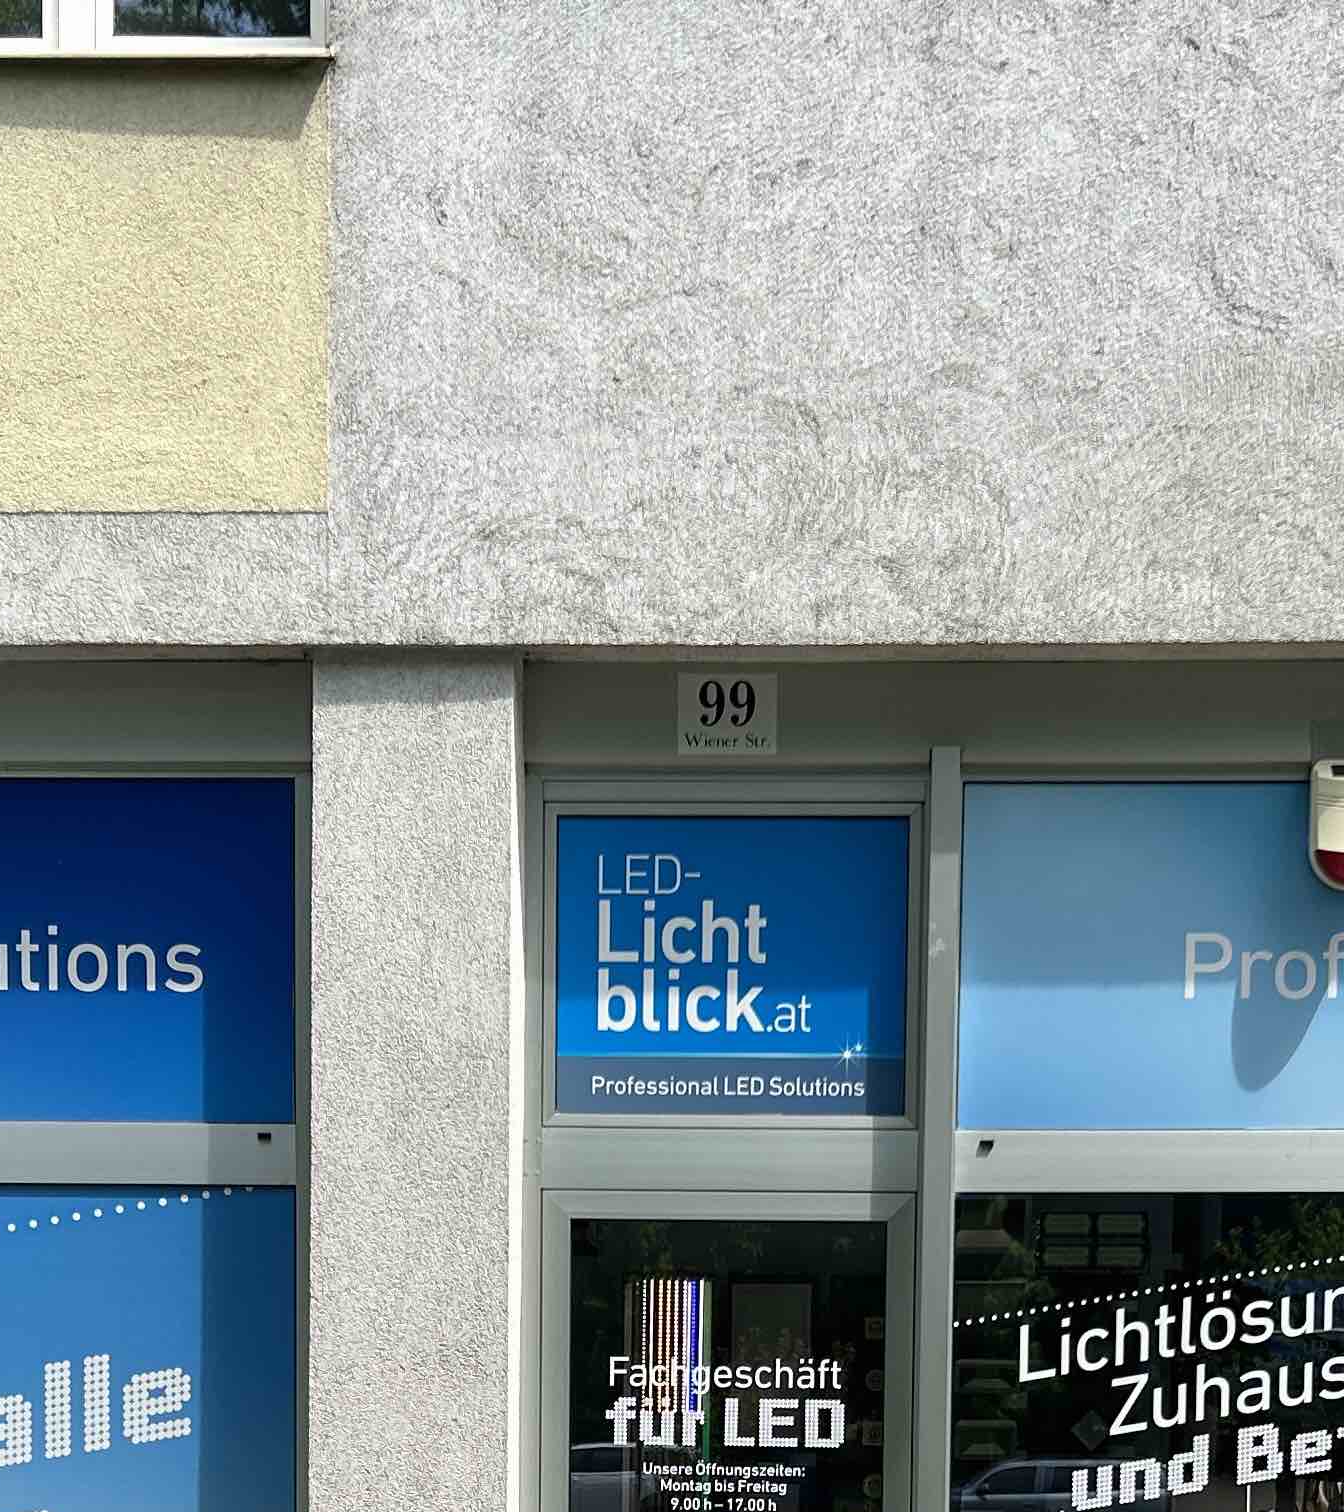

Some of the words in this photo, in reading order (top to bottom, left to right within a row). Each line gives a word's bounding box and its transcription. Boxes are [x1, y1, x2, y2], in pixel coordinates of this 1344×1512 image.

[699, 680, 756, 727] 99
[683, 732, 738, 748] Wiener
[598, 855, 701, 895] LED-
[597, 900, 768, 964] Licht
[597, 967, 811, 1033] blick.at
[592, 1076, 719, 1097] Professional
[723, 1077, 763, 1097] LED
[769, 1077, 865, 1098] Solutions
[608, 1356, 842, 1395] Fachgeschäft
[605, 1396, 705, 1447] für
[723, 1397, 846, 1449] LED
[642, 1462, 693, 1476] Unsere
[696, 1459, 806, 1478] Öffnungszeiten:
[660, 1479, 711, 1495] Montag
[714, 1480, 735, 1492] bis
[738, 1480, 788, 1496] Freitag
[1071, 1434, 1211, 1512] und
[670, 1498, 700, 1511] 9.00
[703, 1498, 712, 1511] h
[727, 1498, 765, 1512] 17.00
[768, 1499, 777, 1512] h
